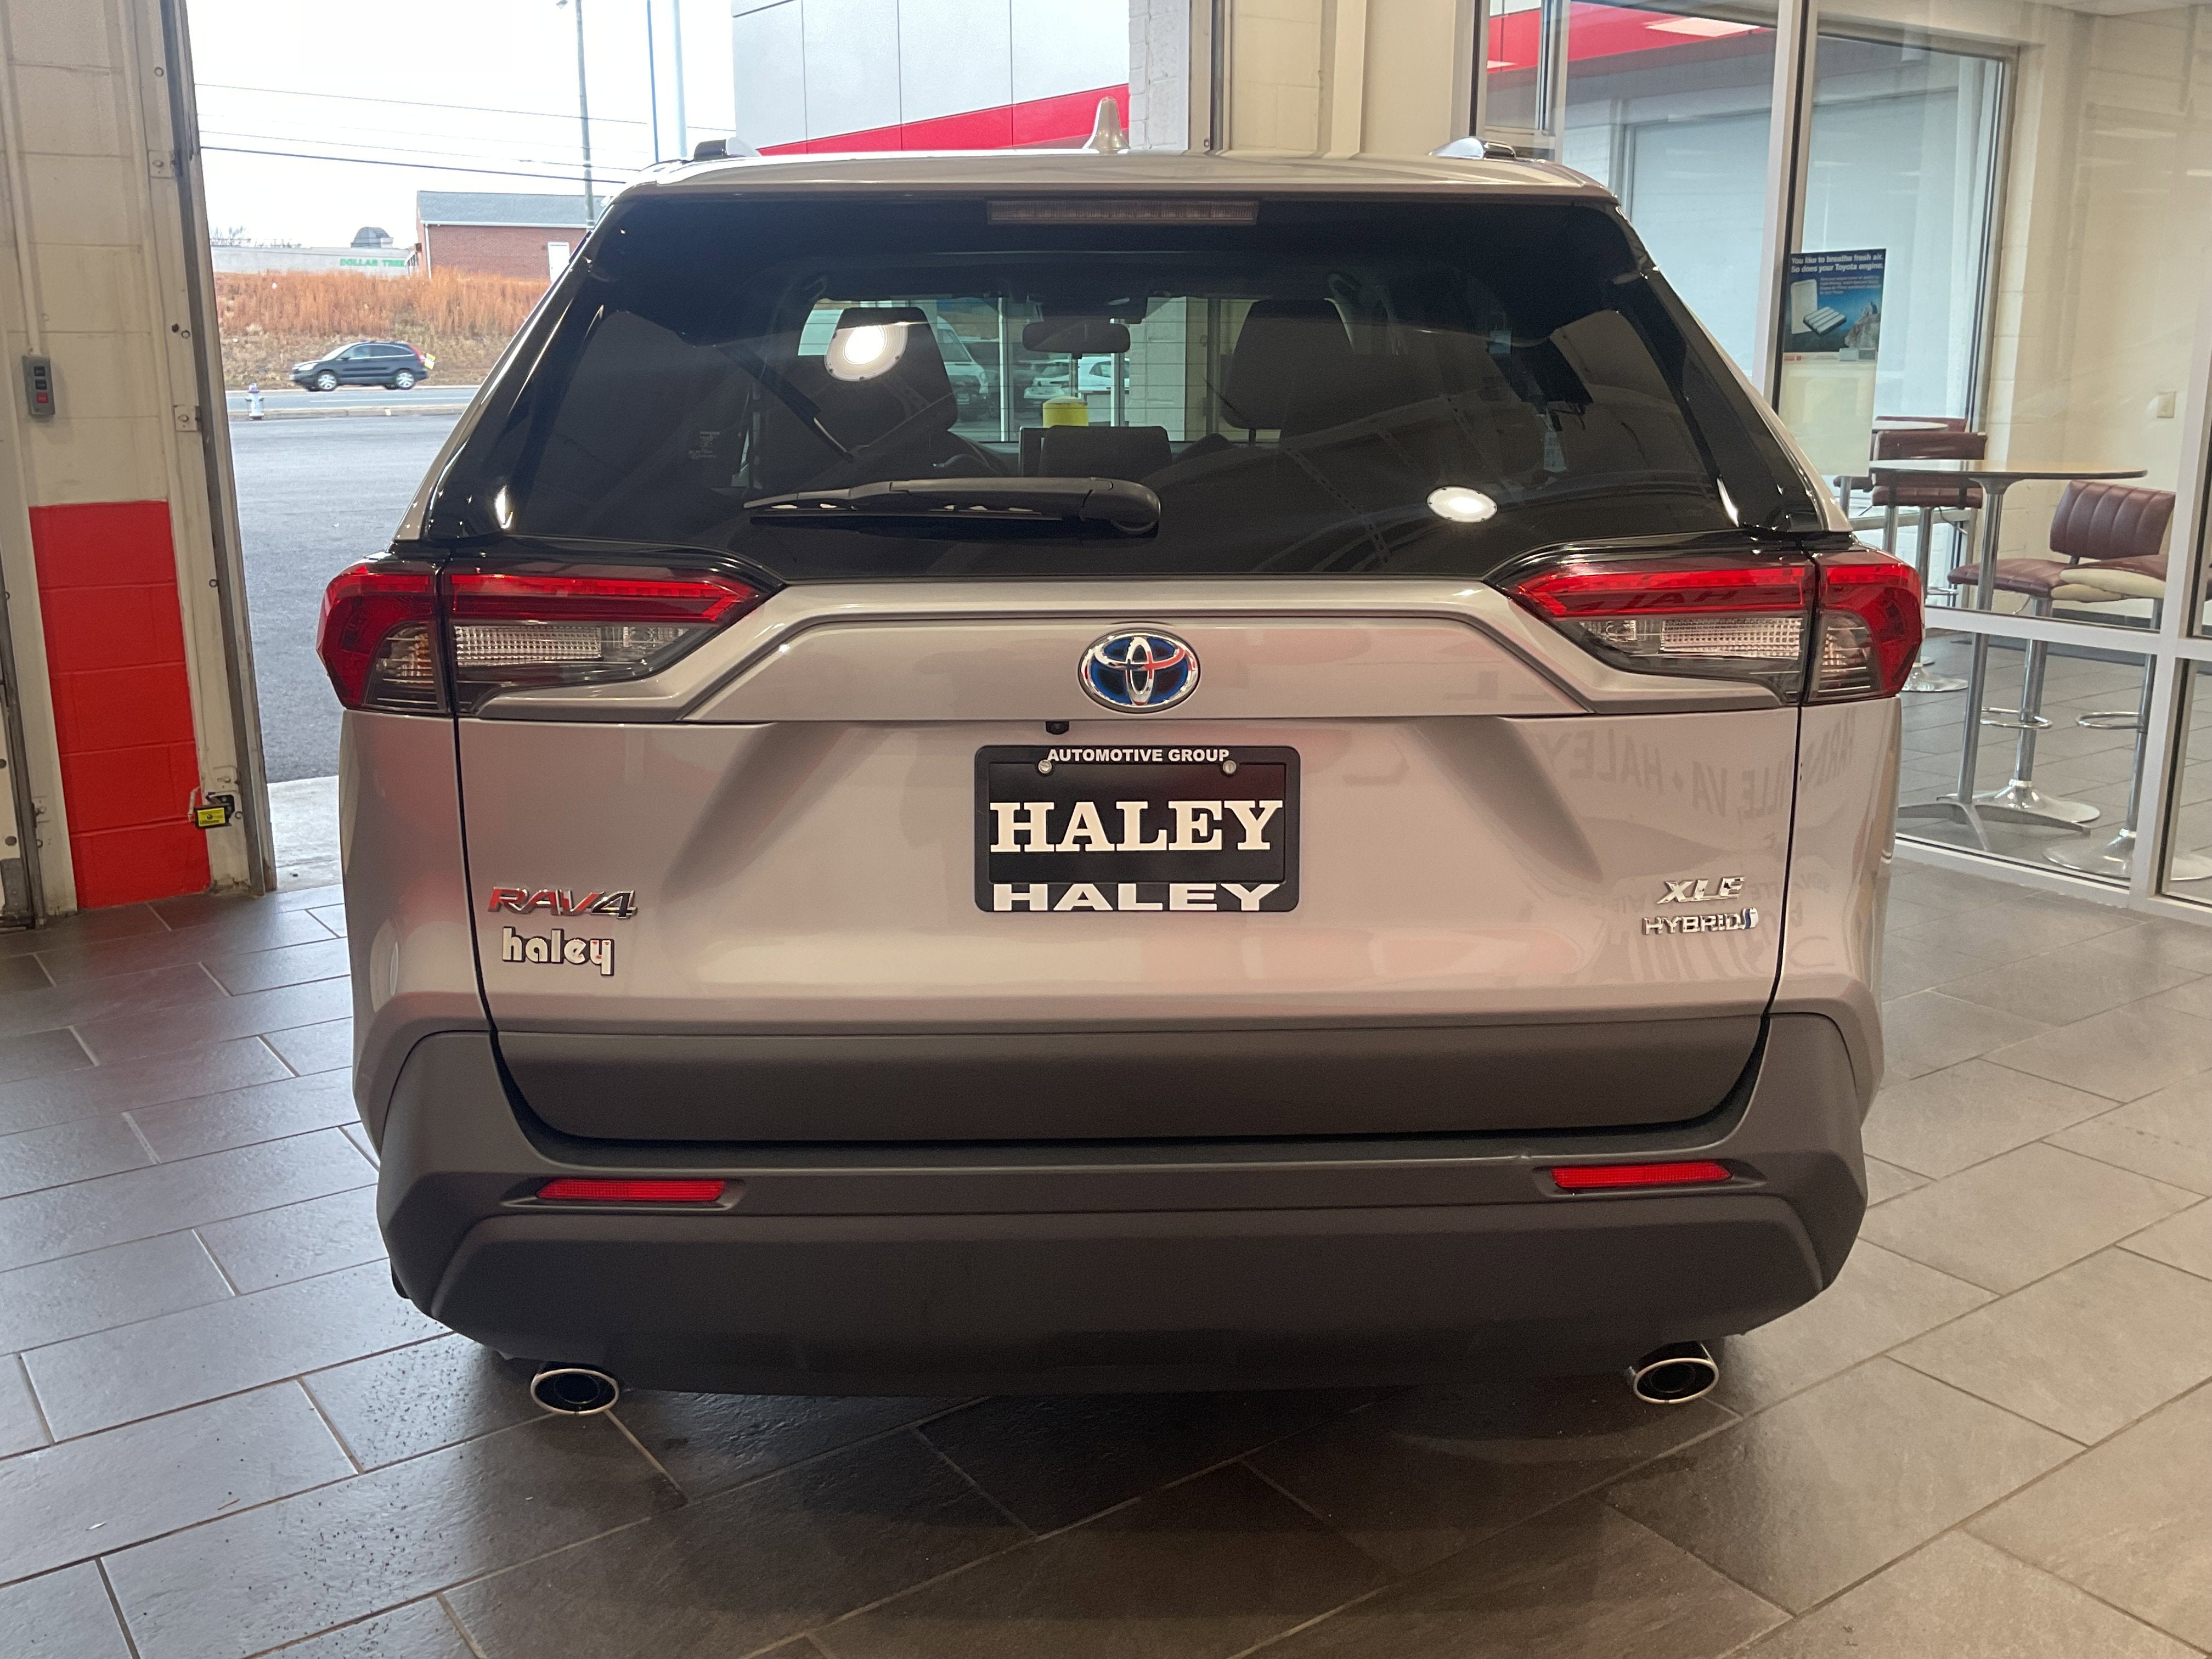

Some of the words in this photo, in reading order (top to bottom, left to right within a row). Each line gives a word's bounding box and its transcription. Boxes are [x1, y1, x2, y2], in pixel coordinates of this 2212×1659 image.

[340, 258, 378, 267] DOLLAR
[1835, 263, 1857, 272] Toyota
[1859, 262, 1883, 271] engine.
[1047, 748, 1163, 762] AUTOMOTIVE
[1167, 748, 1230, 762] GROUP
[990, 800, 1283, 853] HALEY
[488, 887, 637, 919] RAV4
[993, 883, 1280, 911] HALEY
[1656, 876, 1746, 904] XLE
[1642, 913, 1741, 935] HYBRID
[501, 926, 615, 977] haley
